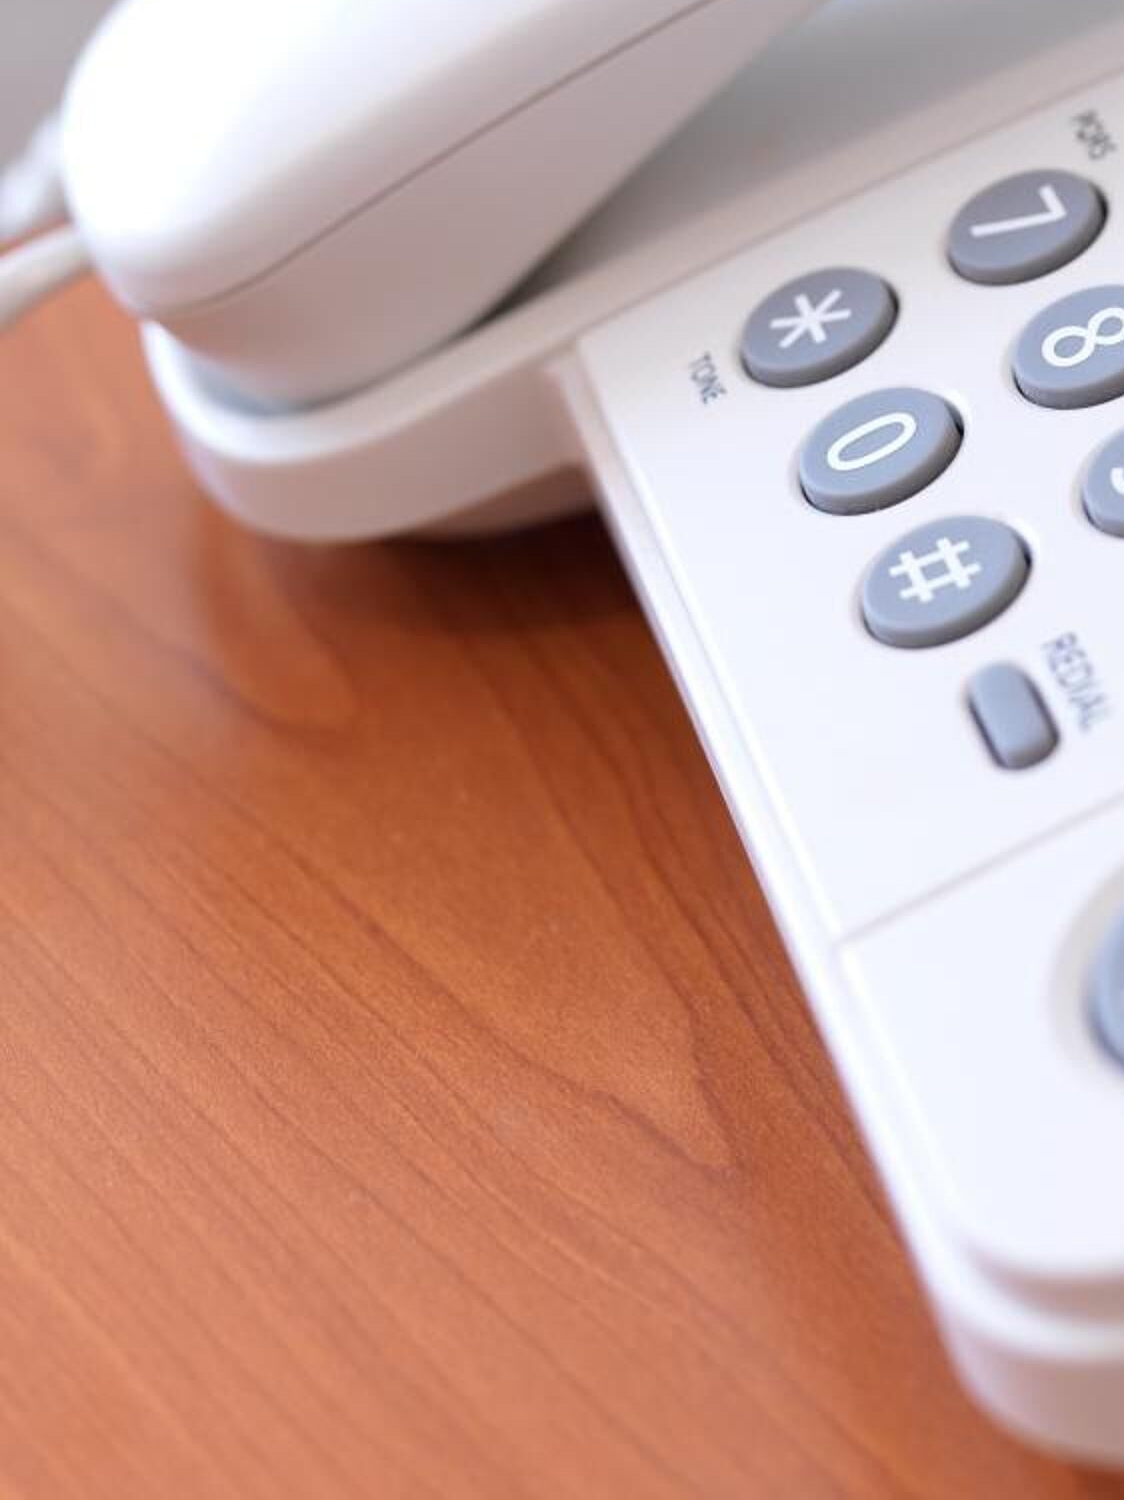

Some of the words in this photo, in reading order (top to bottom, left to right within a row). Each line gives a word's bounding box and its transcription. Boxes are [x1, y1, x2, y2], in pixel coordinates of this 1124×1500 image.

[970, 185, 1067, 237] 7
[688, 351, 727, 404] TONE
[827, 412, 917, 471] 0
[889, 536, 981, 603] #
[1041, 632, 1111, 732] REDIAL
